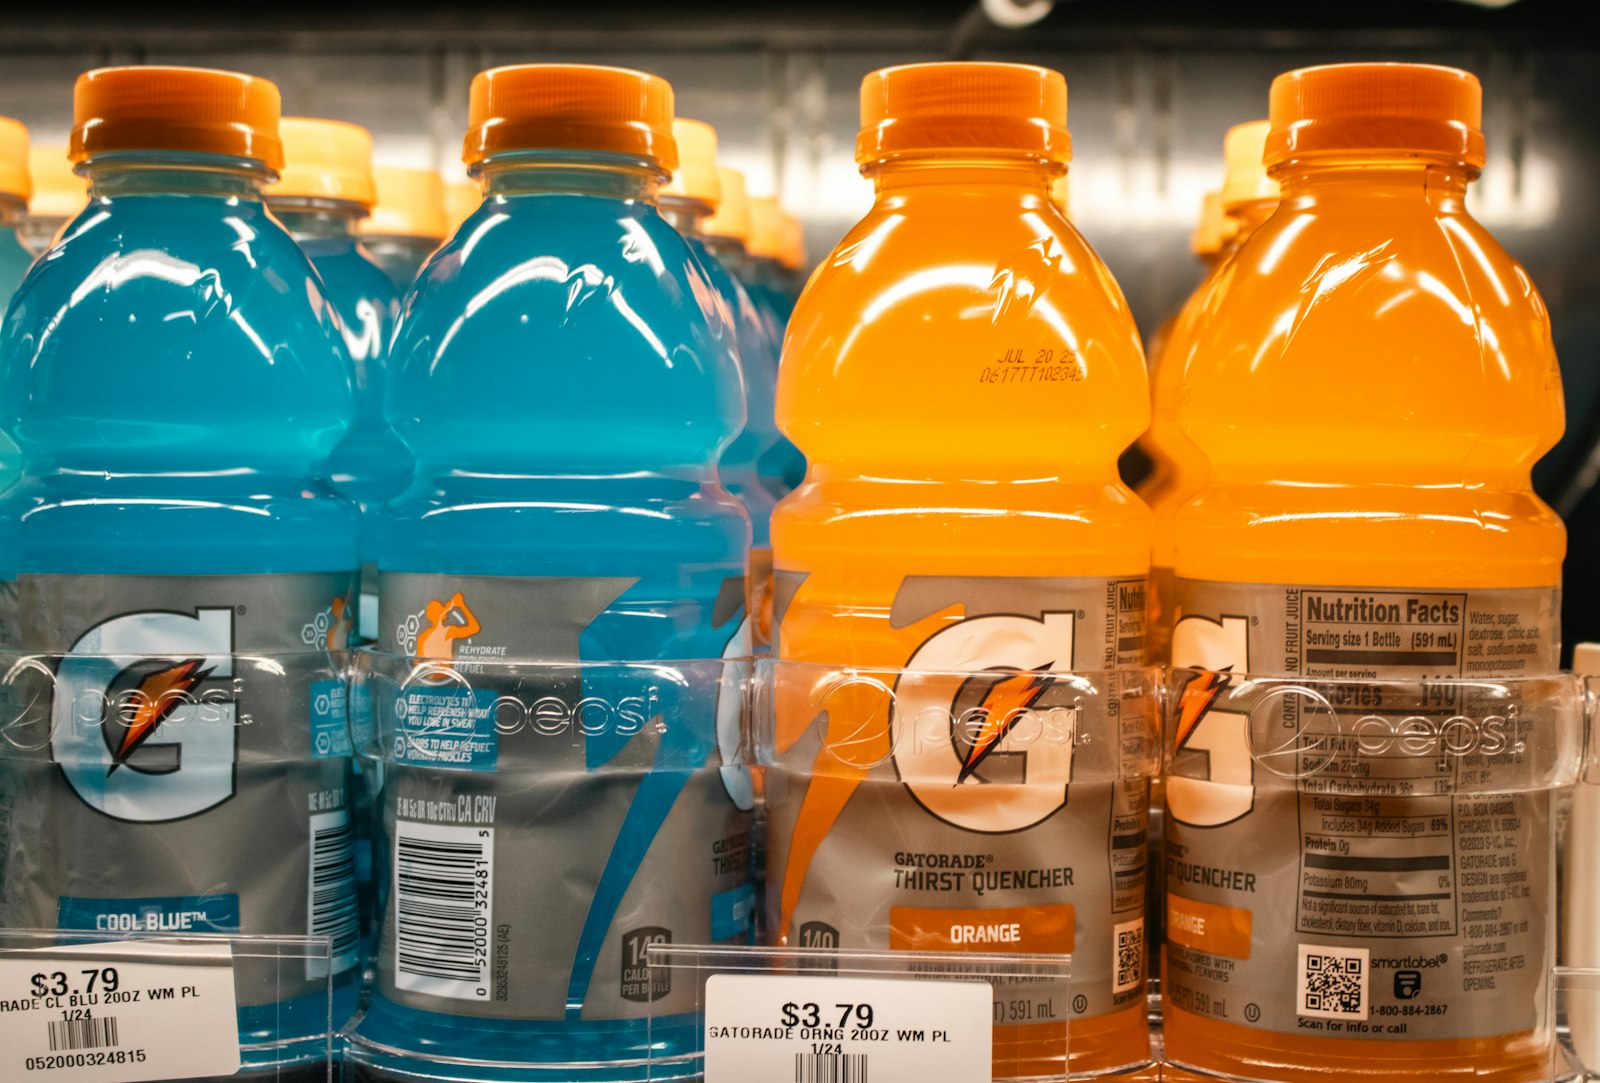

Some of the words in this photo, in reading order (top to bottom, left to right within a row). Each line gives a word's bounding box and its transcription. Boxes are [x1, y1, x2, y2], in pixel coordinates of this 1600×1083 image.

[997, 348, 1025, 364] JUL
[1035, 349, 1054, 364] 20
[1286, 588, 1299, 620] JUICE
[1306, 595, 1400, 623] Nutrition
[1406, 597, 1460, 624] Facts
[1469, 611, 1496, 626] Water,
[1286, 622, 1298, 656] FRUIT
[1305, 629, 1341, 649] Serving
[1341, 631, 1362, 647] size
[1363, 631, 1370, 646] 1
[1372, 631, 1401, 648] Bottle
[1410, 633, 1433, 650] (591
[1436, 633, 1457, 649] mL)
[459, 645, 507, 656] REHYDRATE
[1285, 655, 1298, 672] NO
[1305, 666, 1334, 678] Amount
[457, 794, 472, 823] CA
[474, 795, 497, 824] CRV
[1312, 797, 1332, 810] Total
[1333, 798, 1363, 814] Sugars
[1363, 801, 1380, 815] 34g
[479, 830, 490, 838] 5
[1321, 818, 1355, 831] Includes
[1356, 819, 1373, 835] 34g
[1374, 820, 1400, 833] Added
[1401, 821, 1425, 836] Sugars
[1304, 836, 1337, 849] Protein
[1338, 839, 1350, 854] 0g
[1460, 854, 1498, 870] GATORADE
[475, 860, 489, 910] 32481
[894, 869, 966, 892] THIRST
[972, 867, 1075, 896] QUENCHER
[1176, 861, 1256, 893] QUENCHER
[1303, 872, 1343, 890] Potassium
[1344, 874, 1368, 892] 80mg
[1438, 873, 1451, 888] 0%
[96, 914, 141, 931] COOL
[474, 916, 487, 968] 52000
[950, 923, 1021, 944] ORANGE
[1195, 964, 1230, 983] FLAVORS
[1213, 957, 1235, 972] WITH
[30, 967, 120, 999] $3.79
[475, 987, 487, 997] 0
[622, 983, 640, 996] PER
[641, 982, 670, 994] BTTLE
[46, 997, 64, 1009] CL
[69, 993, 99, 1007] BLU
[147, 987, 175, 1001] WM
[181, 986, 201, 999] PL
[61, 1008, 93, 1022] 1/24
[780, 1001, 875, 1030] $3.79
[1009, 999, 1033, 1020] 591
[1037, 998, 1056, 1018] mL
[1213, 998, 1228, 1019] mL
[1369, 1004, 1448, 1017] 1-800-884-2867
[709, 1026, 794, 1040] GATORADE
[800, 1027, 845, 1041] ORNG
[896, 1030, 925, 1042] WM
[931, 1030, 952, 1043] PL
[1297, 1017, 1324, 1031] Scan
[1326, 1020, 1342, 1032] for
[1346, 1021, 1370, 1033] info
[1371, 1024, 1384, 1034] or
[1387, 1022, 1408, 1034] call
[810, 1043, 844, 1056] 1/24
[25, 1049, 147, 1072] 052000324815
